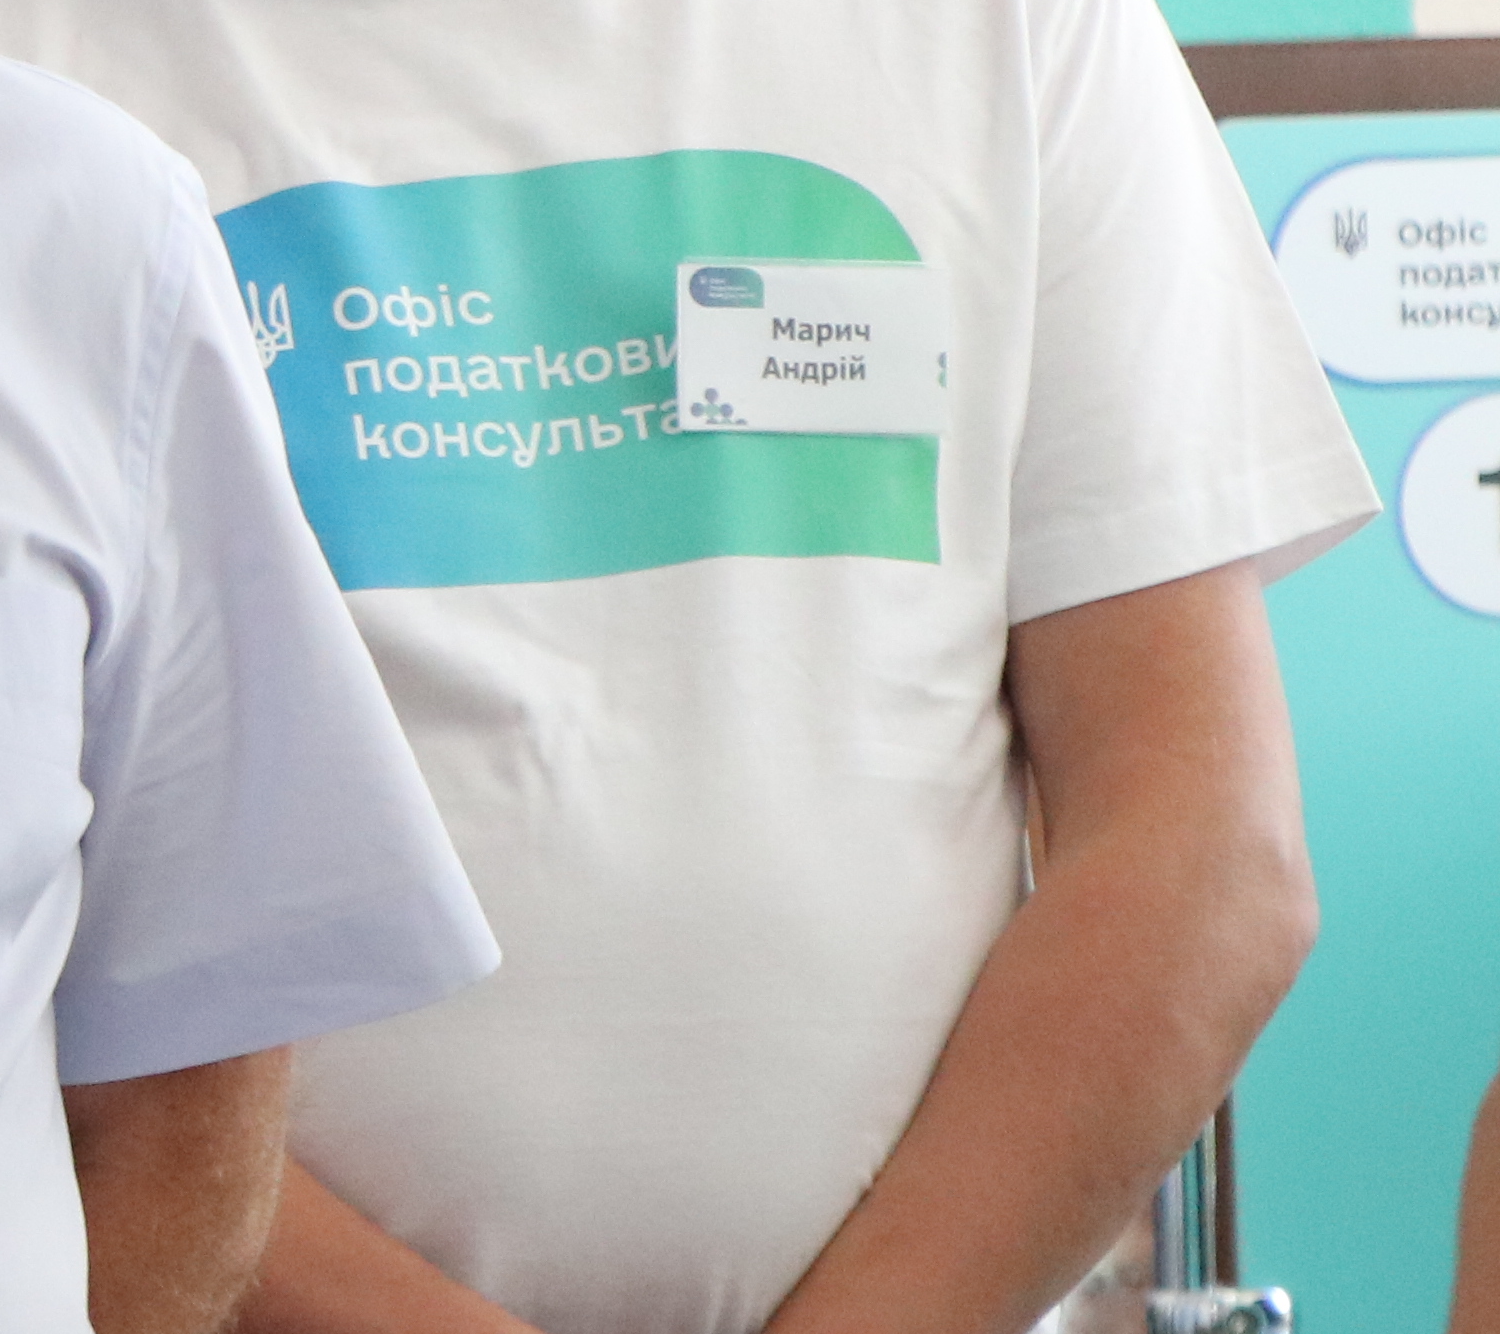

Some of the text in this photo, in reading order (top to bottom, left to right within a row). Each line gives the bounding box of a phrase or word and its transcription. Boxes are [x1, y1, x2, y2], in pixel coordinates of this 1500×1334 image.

[1398, 218, 1488, 250] Офіс
[332, 283, 495, 338] Офіс
[771, 316, 872, 348] Марич
[760, 354, 867, 386] Андрій
